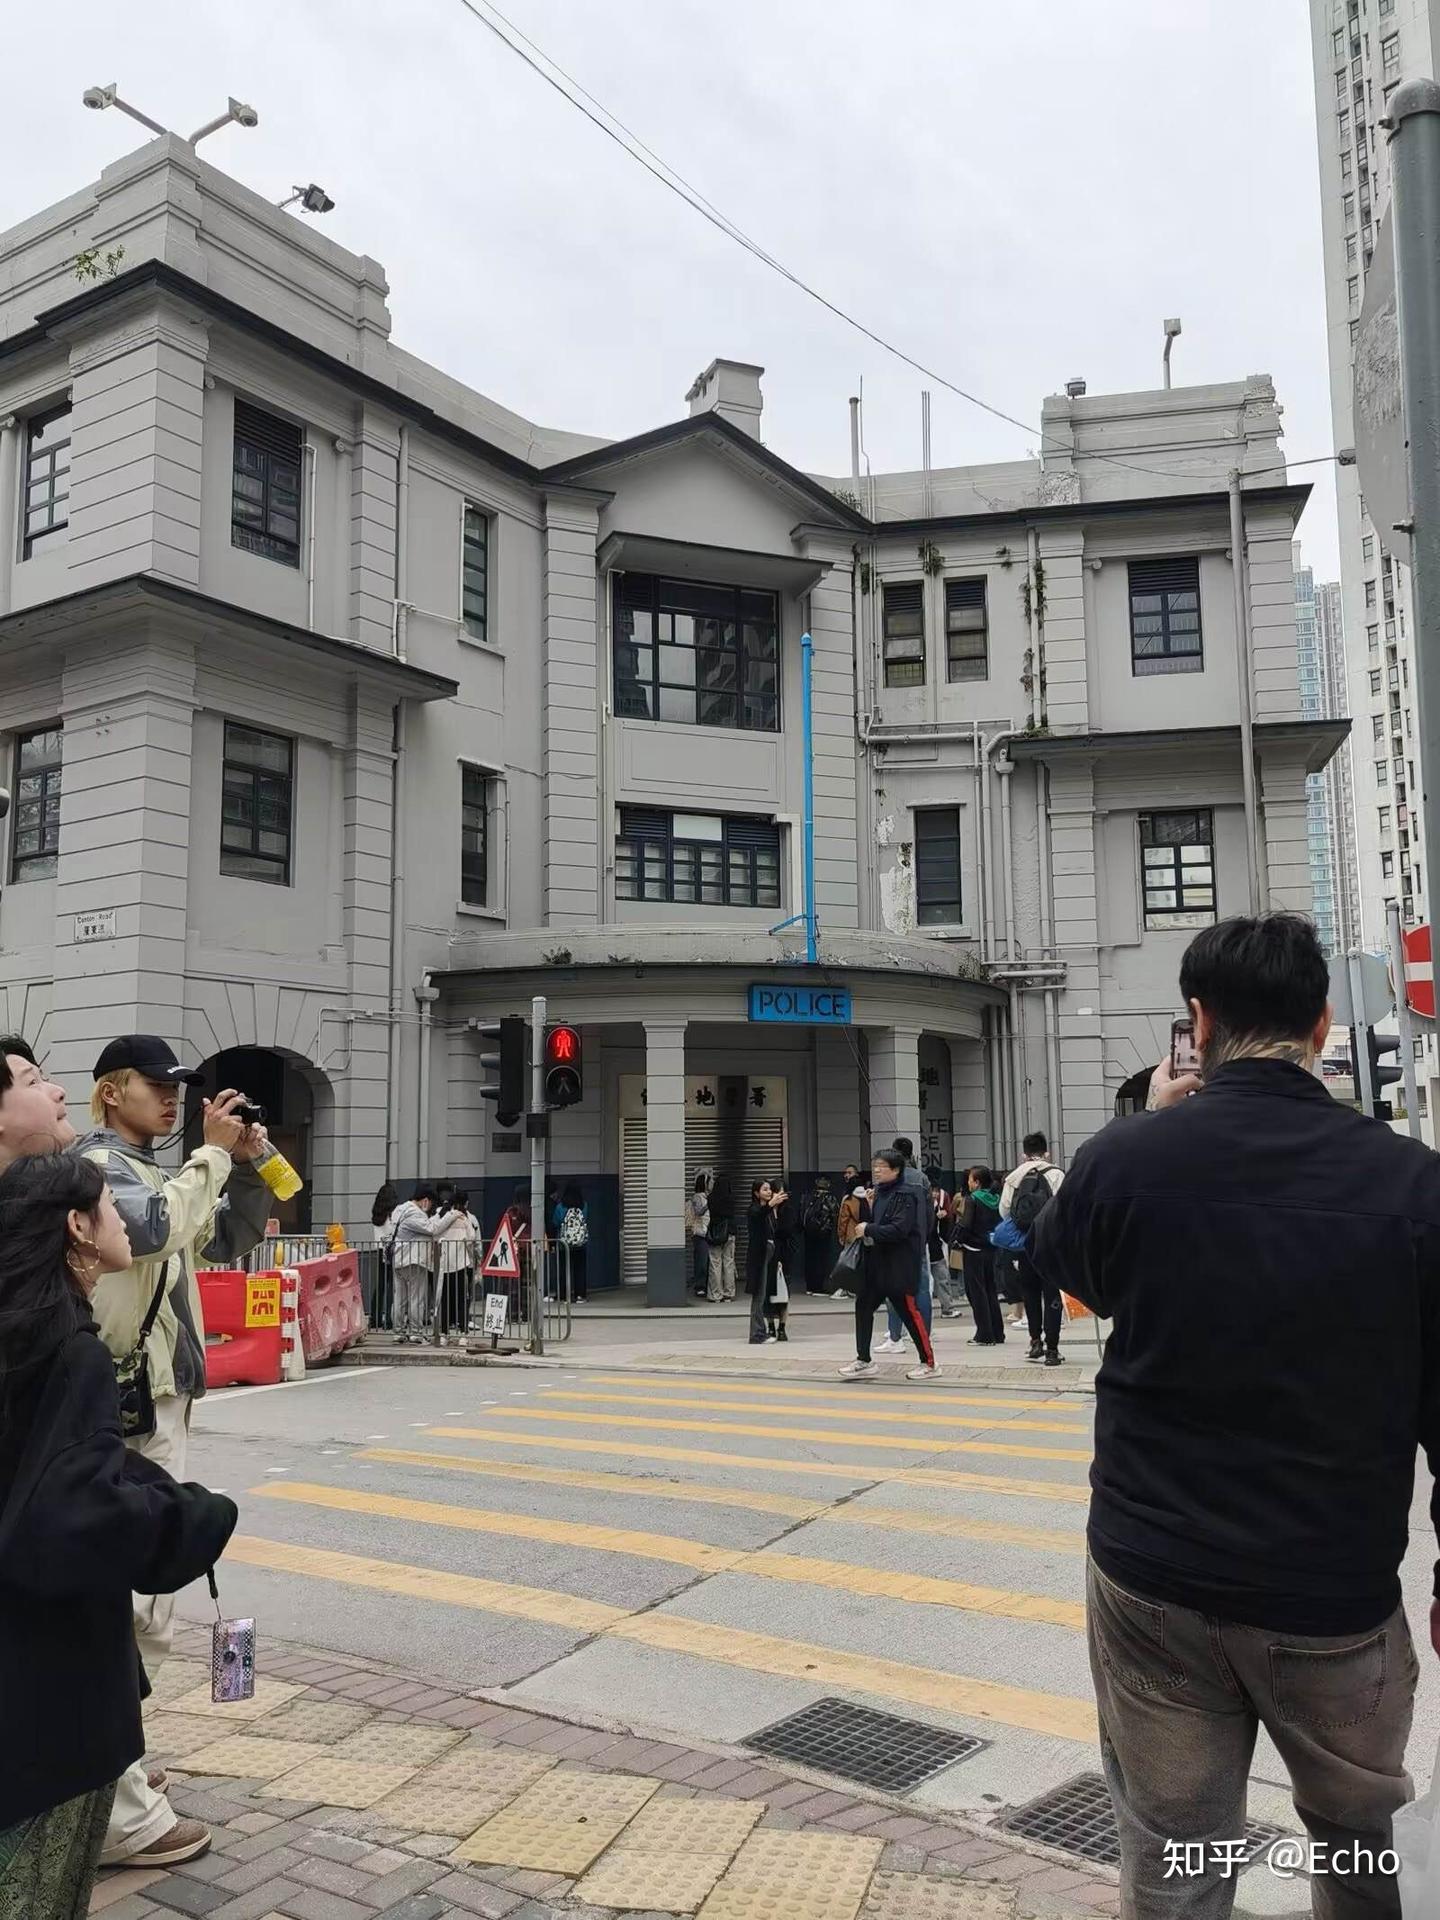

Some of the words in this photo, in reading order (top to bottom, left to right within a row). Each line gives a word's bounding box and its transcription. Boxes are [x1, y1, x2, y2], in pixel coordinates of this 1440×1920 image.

[760, 991, 846, 1017] POLICE
[491, 1297, 503, 1309] End
[486, 1312, 503, 1330] 終止
